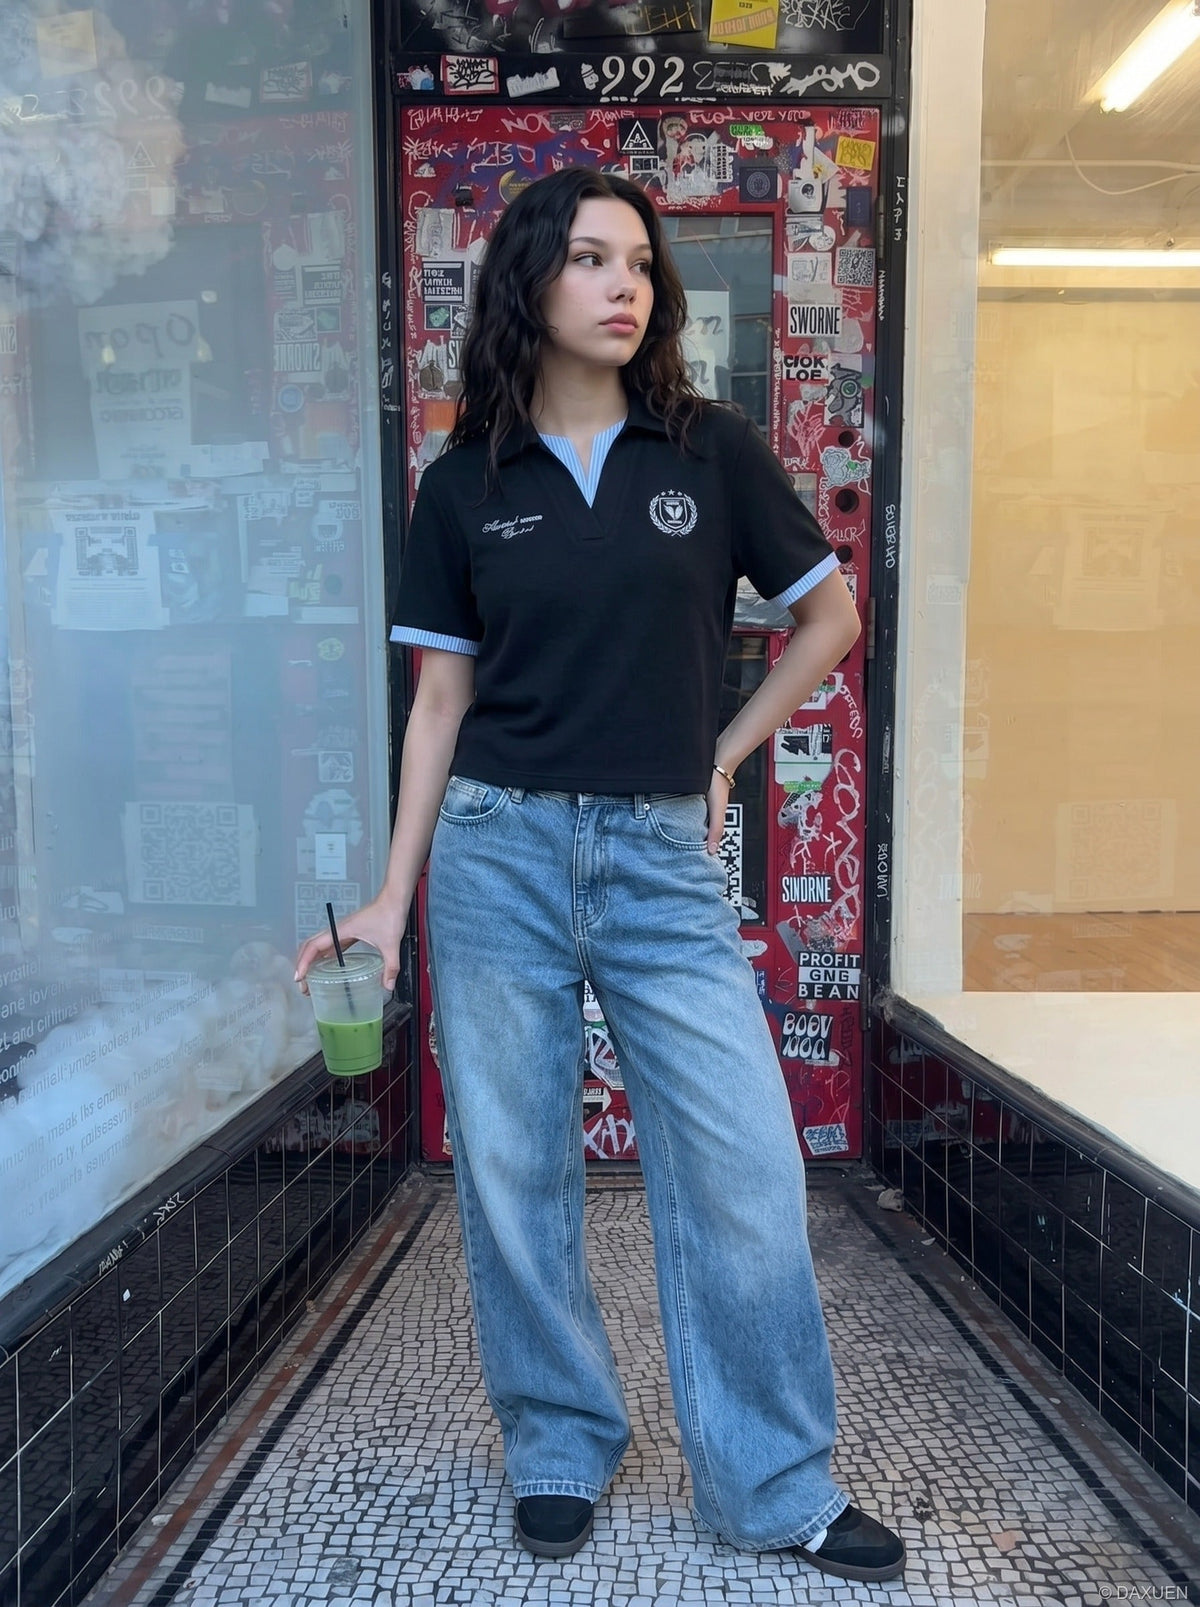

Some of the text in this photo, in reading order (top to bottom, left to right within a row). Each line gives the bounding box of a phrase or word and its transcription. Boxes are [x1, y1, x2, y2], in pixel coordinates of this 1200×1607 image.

[601, 56, 685, 97] 992
[790, 306, 841, 335] SWORNE
[786, 369, 821, 381] LOE
[800, 952, 860, 968] PROFIT
[798, 984, 859, 1000] BEAN
